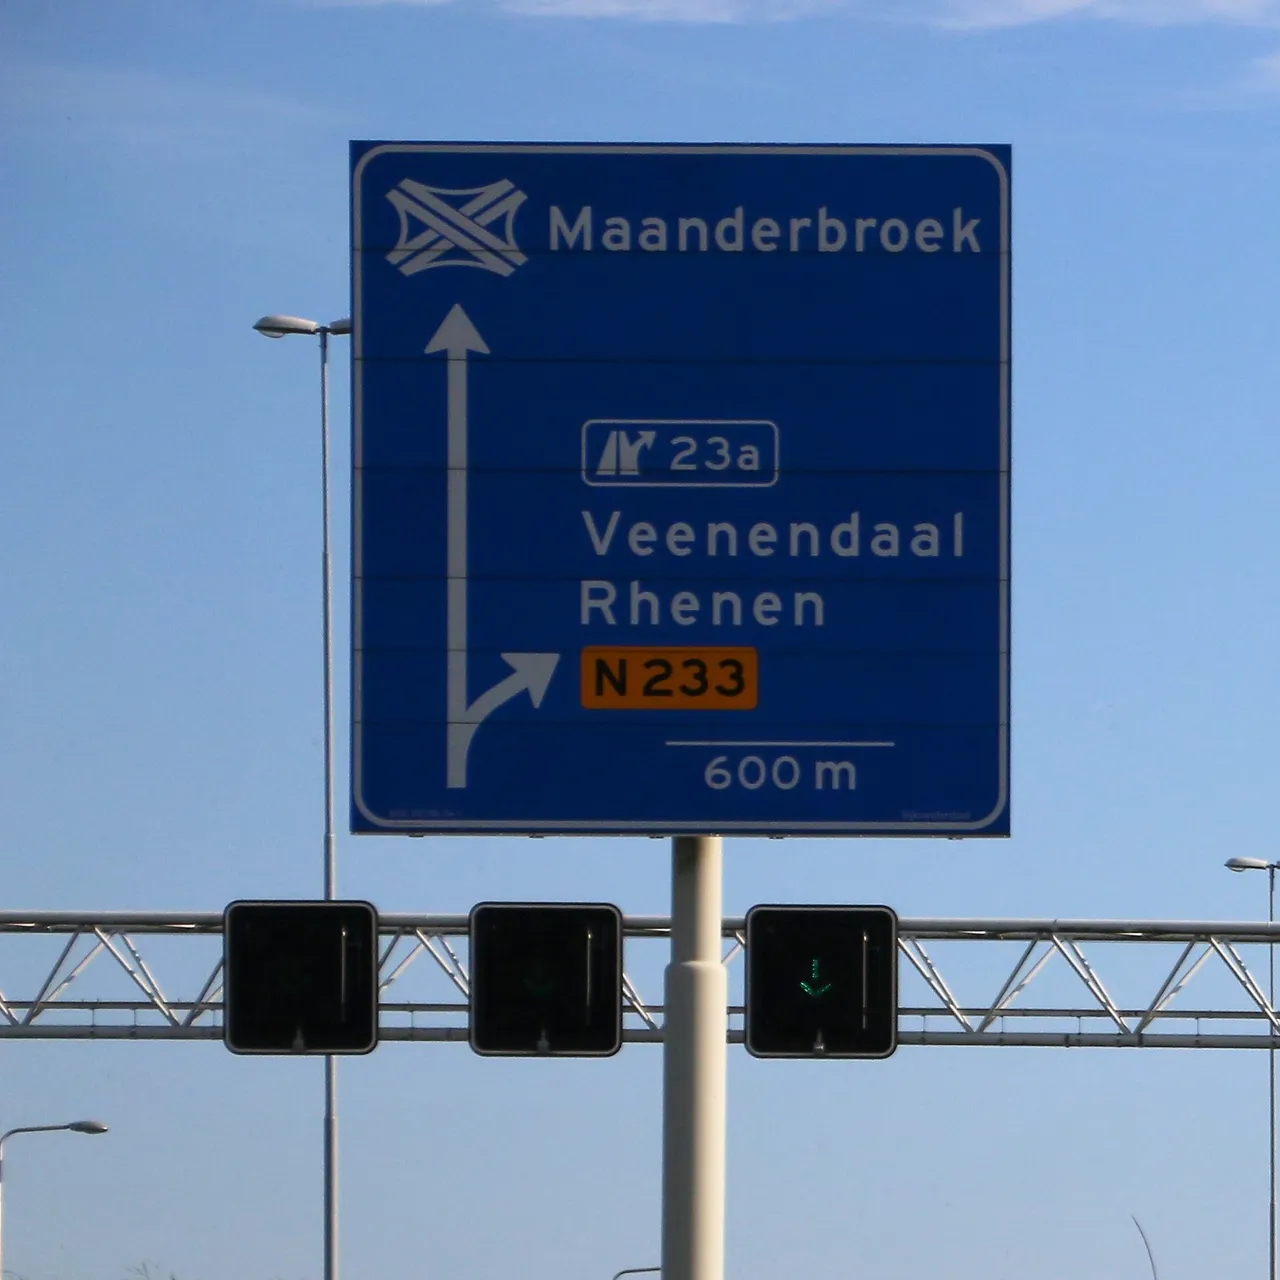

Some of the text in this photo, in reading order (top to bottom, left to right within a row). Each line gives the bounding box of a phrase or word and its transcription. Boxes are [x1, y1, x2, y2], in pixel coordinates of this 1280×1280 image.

[548, 205, 983, 254] Maanderbroek
[669, 435, 762, 472] 23a
[580, 510, 965, 557] Veenendaal
[580, 579, 826, 627] Rhenen
[593, 657, 747, 698] N 233
[704, 754, 857, 791] 600 m
